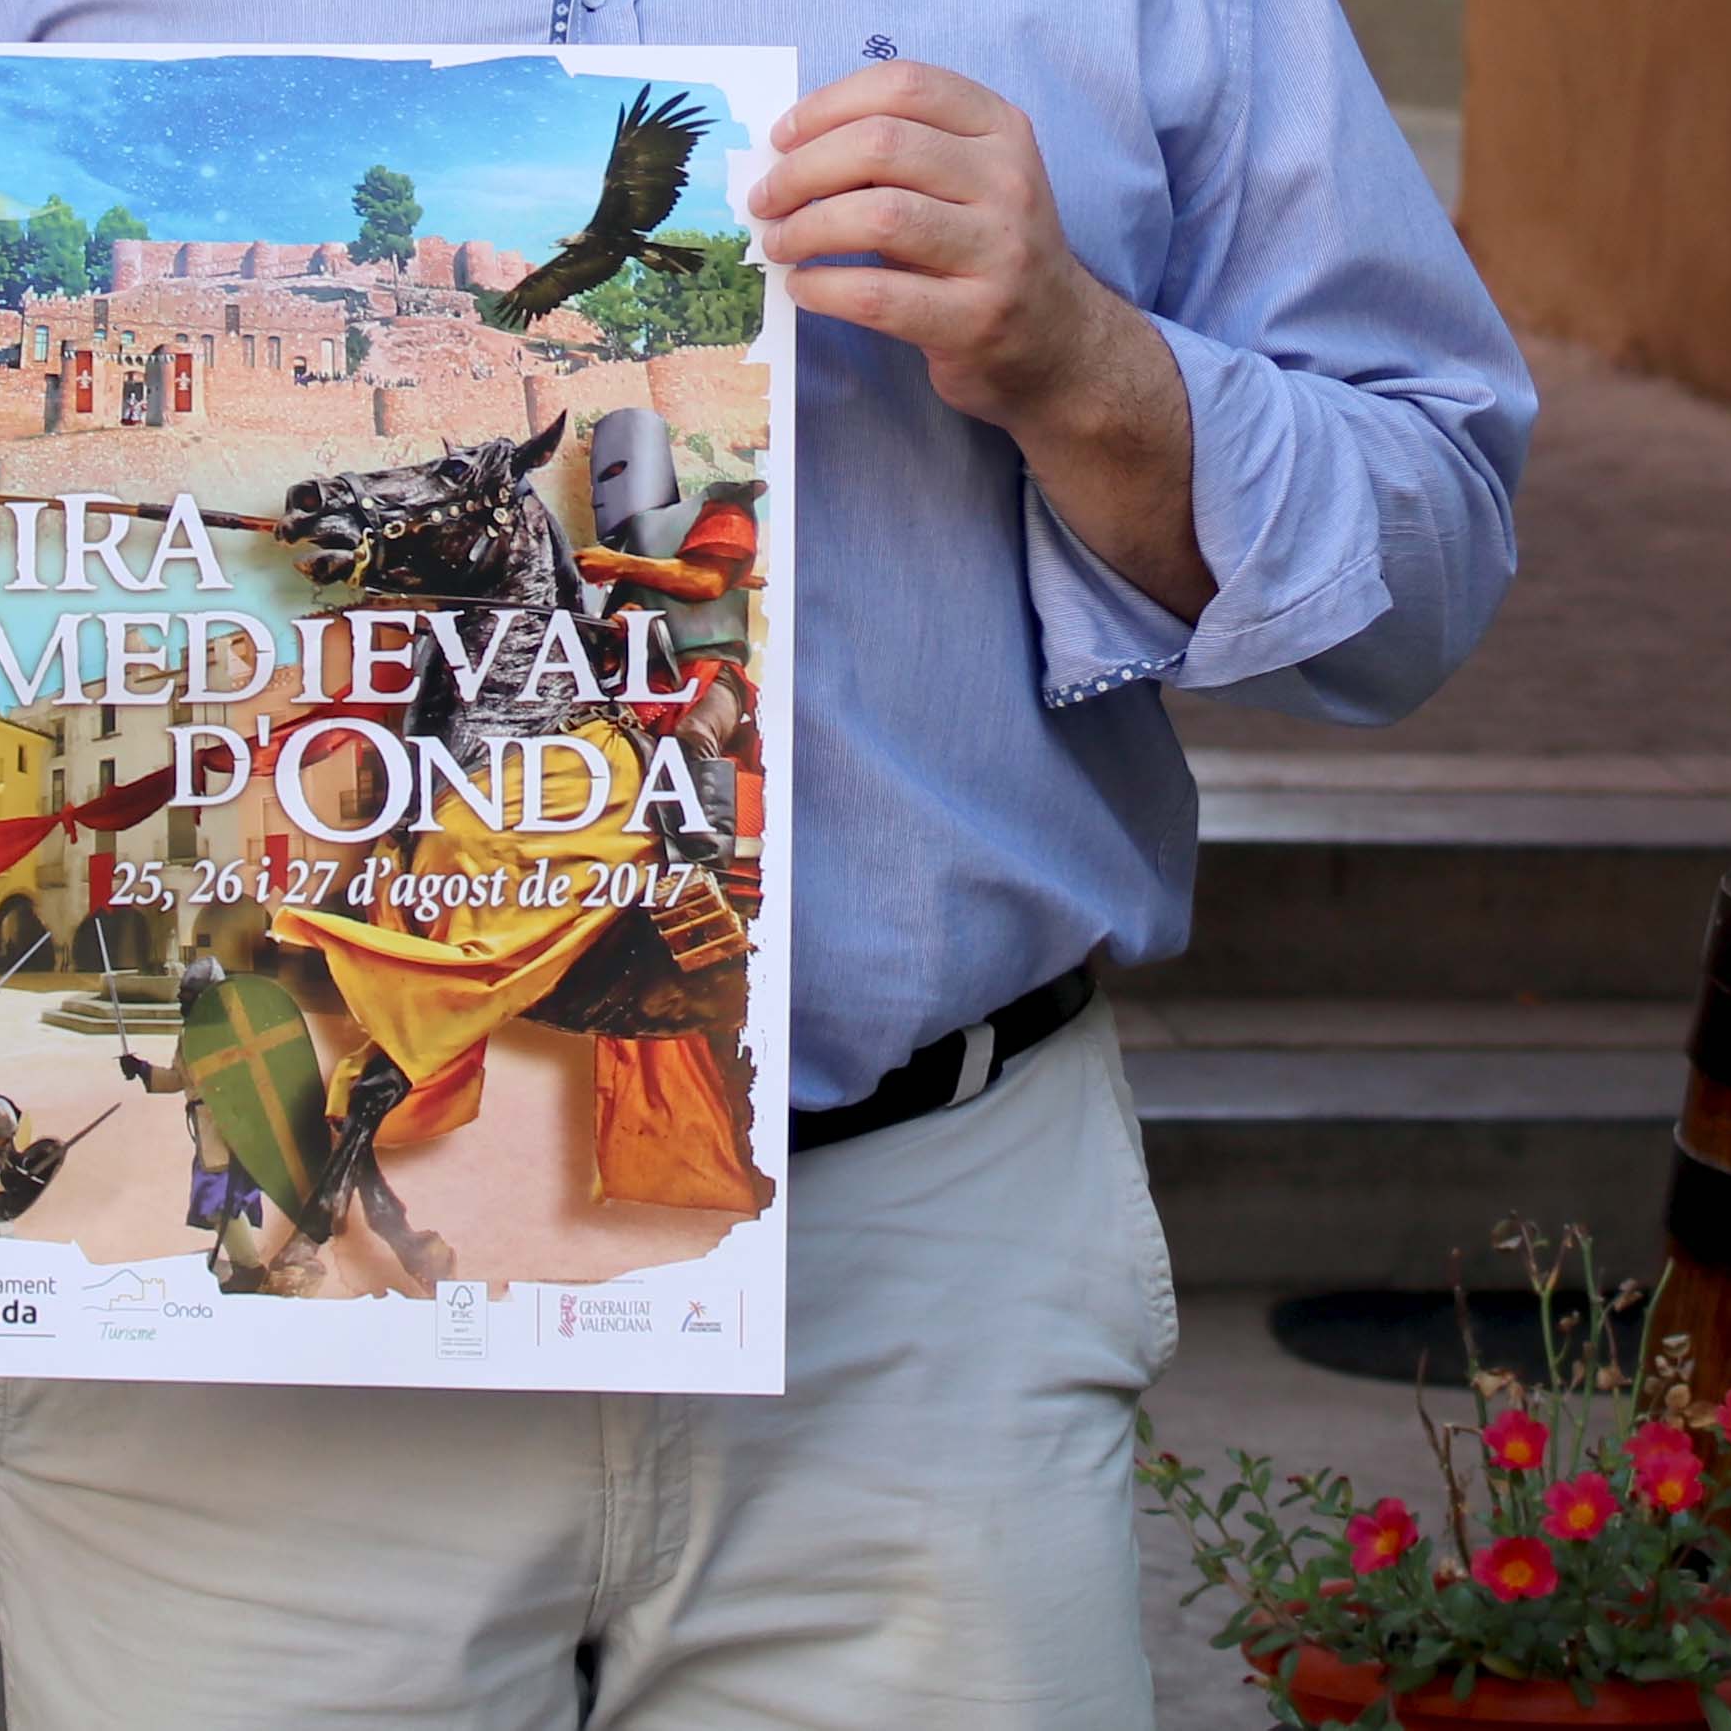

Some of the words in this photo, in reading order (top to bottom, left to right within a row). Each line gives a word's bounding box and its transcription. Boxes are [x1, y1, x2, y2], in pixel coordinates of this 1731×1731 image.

[168, 714, 717, 843] D'ONDA
[108, 860, 174, 912] 25,
[186, 860, 244, 906] 26
[255, 856, 271, 906] i
[283, 860, 340, 907] 27
[516, 857, 570, 907] de
[580, 861, 695, 910] 2017
[163, 1301, 214, 1319] Onda
[579, 1300, 652, 1316] GENERALITAT
[99, 1322, 158, 1341] Turisme
[579, 1317, 653, 1334] VALENCIANA
